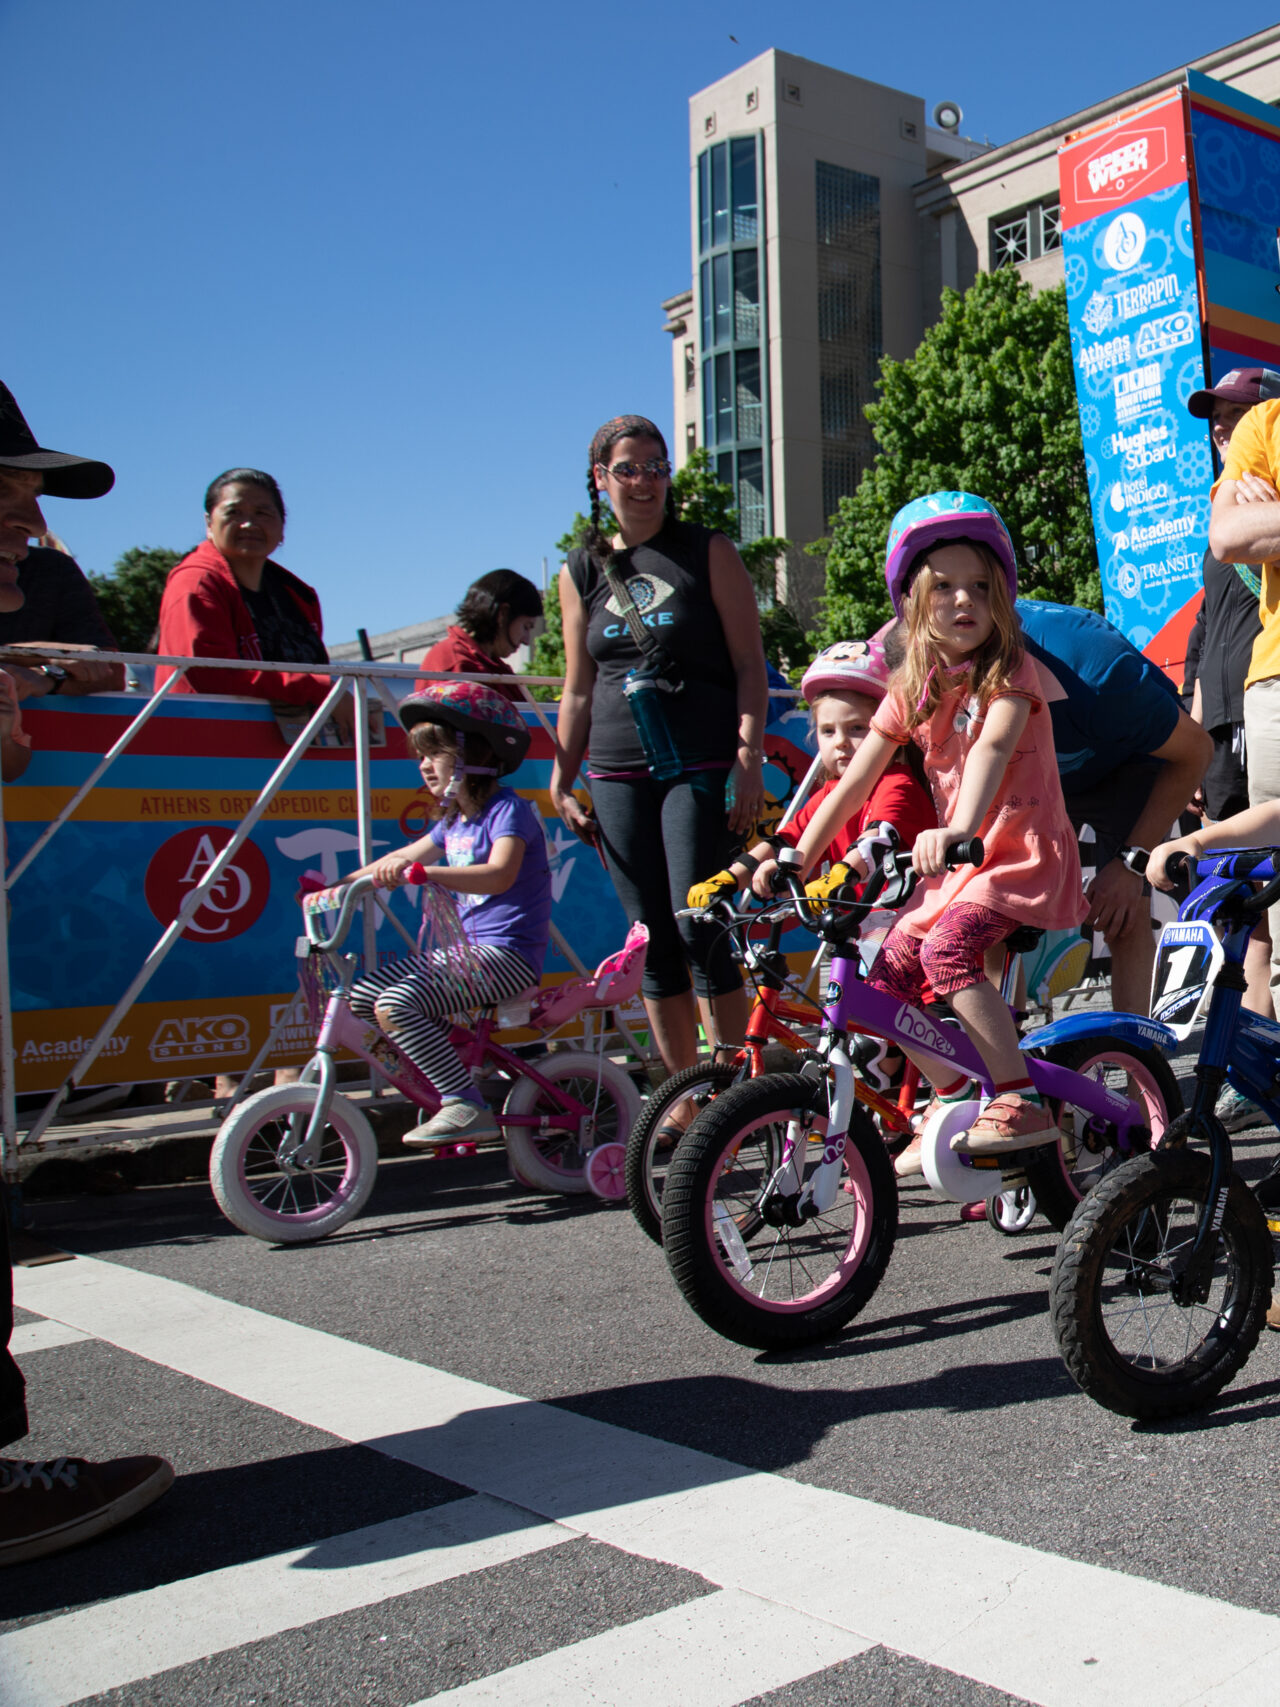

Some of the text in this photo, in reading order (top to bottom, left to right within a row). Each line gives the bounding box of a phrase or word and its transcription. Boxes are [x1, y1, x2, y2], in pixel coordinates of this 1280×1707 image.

[1088, 137, 1148, 173] SPEED
[1088, 153, 1148, 194] WEEK
[1114, 273, 1180, 317] TERRAPIN
[1140, 313, 1192, 346] AKO
[1079, 335, 1131, 368] Athens
[1085, 352, 1131, 378] JAYCEES
[1112, 424, 1168, 455] Hughes
[1126, 443, 1177, 470] Subaru
[1123, 475, 1148, 493] hotel
[1125, 484, 1168, 508] INDIGO
[1131, 514, 1197, 545] Academy
[1140, 552, 1198, 580] TRANSIT
[140, 796, 211, 815] ATHENS
[219, 796, 329, 814] ORTOPEDIC
[1170, 928, 1204, 943] YAMAHA
[1163, 945, 1197, 996] 1
[153, 1015, 249, 1047] AKO
[898, 1003, 953, 1054] honey
[1137, 1024, 1168, 1044] YAMAHA
[159, 1040, 243, 1057] SIGNS
[1211, 1187, 1230, 1231] YAMAHA
